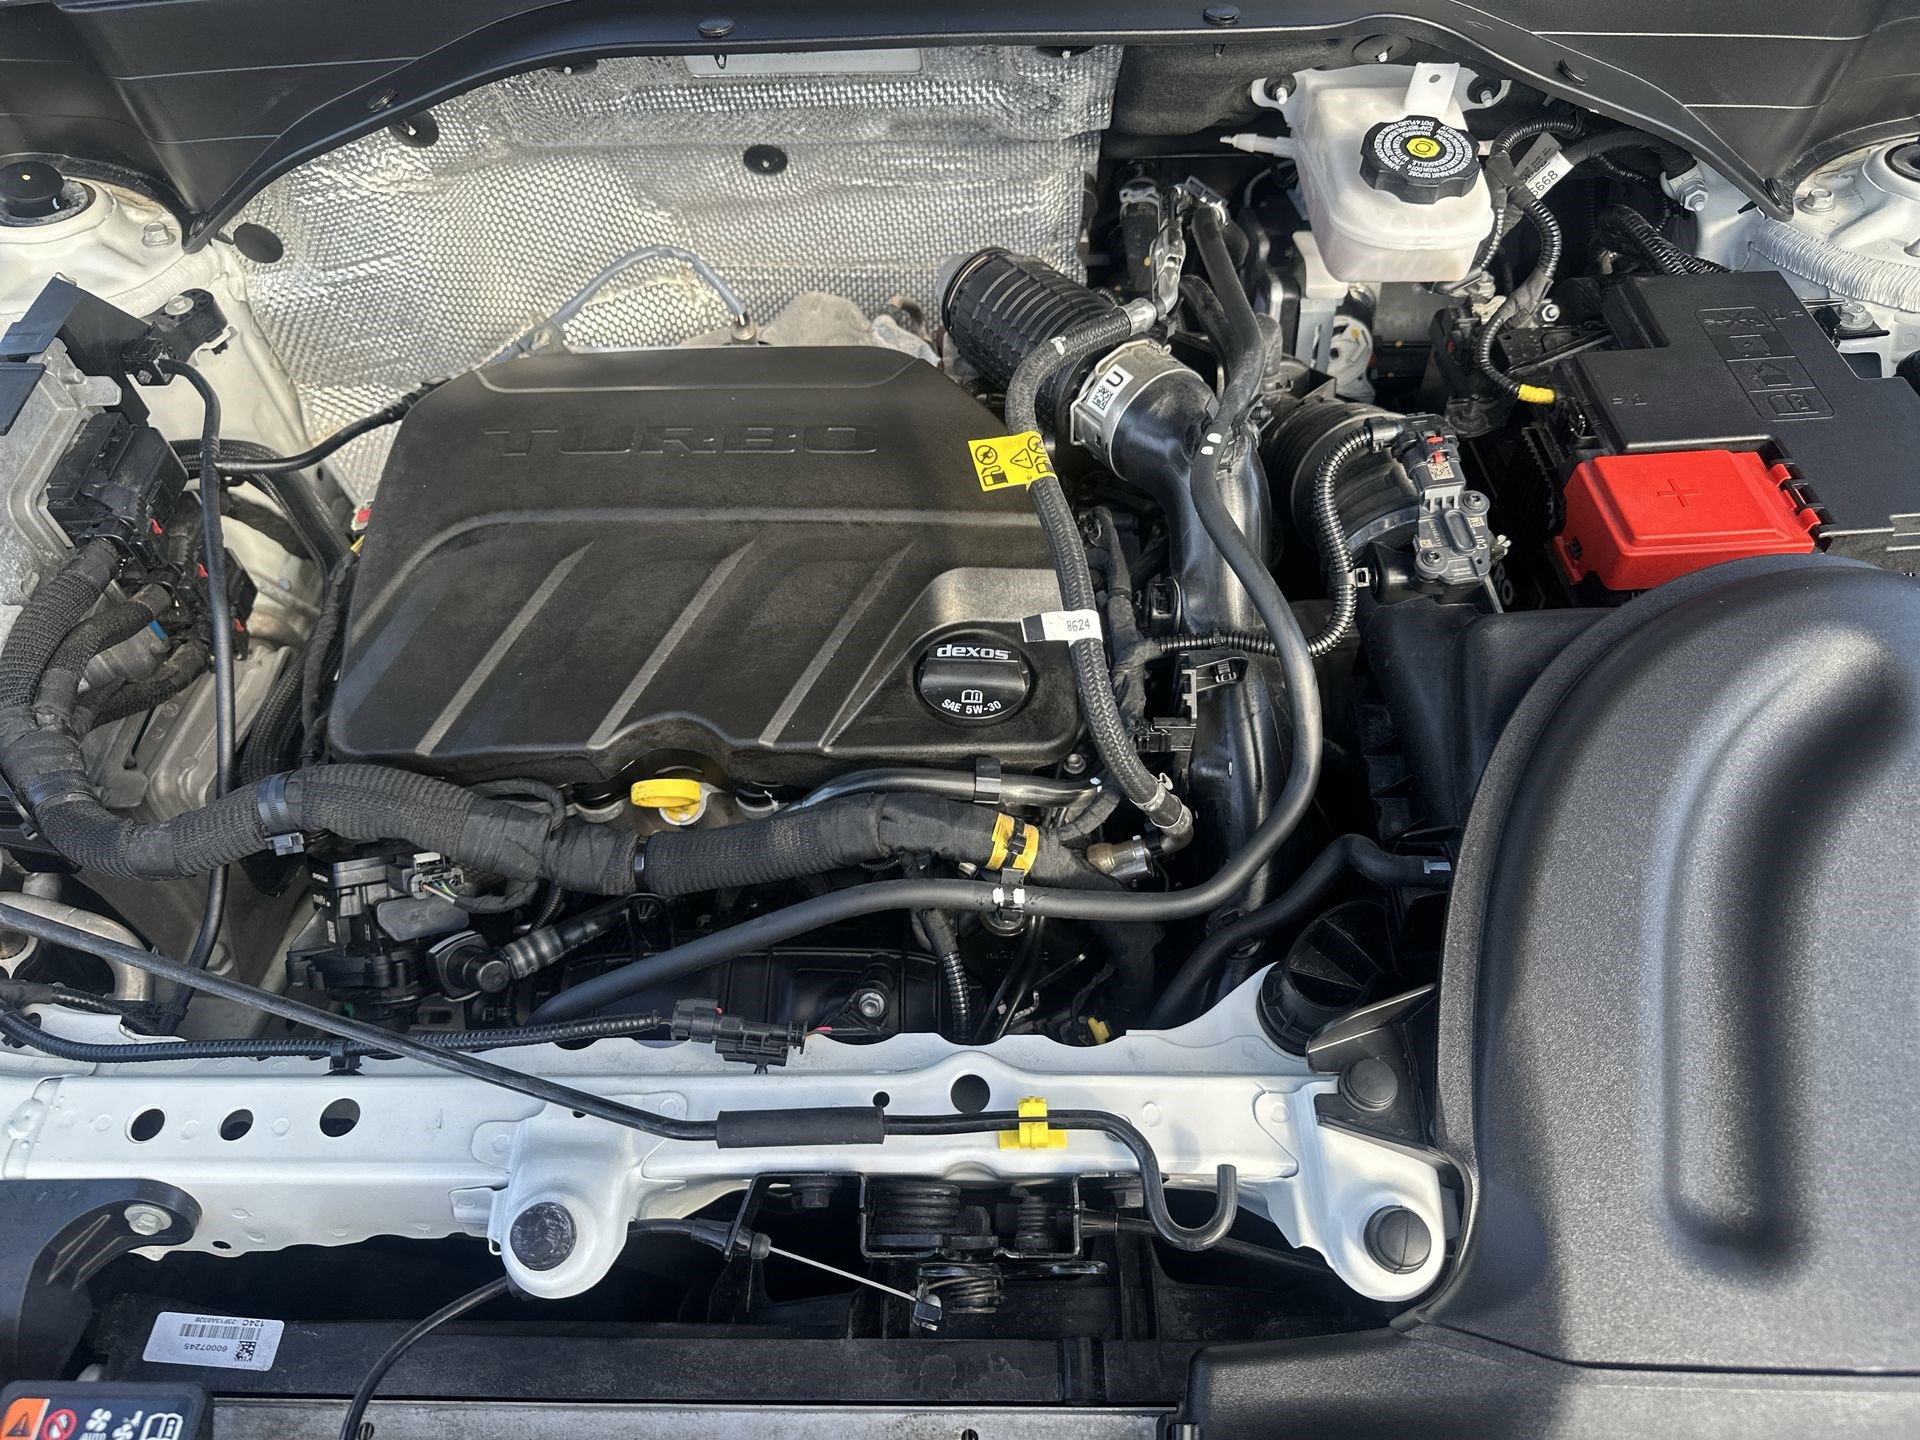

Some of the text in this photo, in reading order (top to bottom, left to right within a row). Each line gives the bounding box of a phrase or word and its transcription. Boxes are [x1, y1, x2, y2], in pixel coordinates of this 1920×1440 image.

[1106, 371, 1124, 388] U
[484, 425, 878, 456] TURBO
[1066, 618, 1091, 632] 8624
[936, 644, 1009, 660] dexos
[942, 699, 1002, 714] SAE 5W-30
[184, 1343, 228, 1352] 60007245
